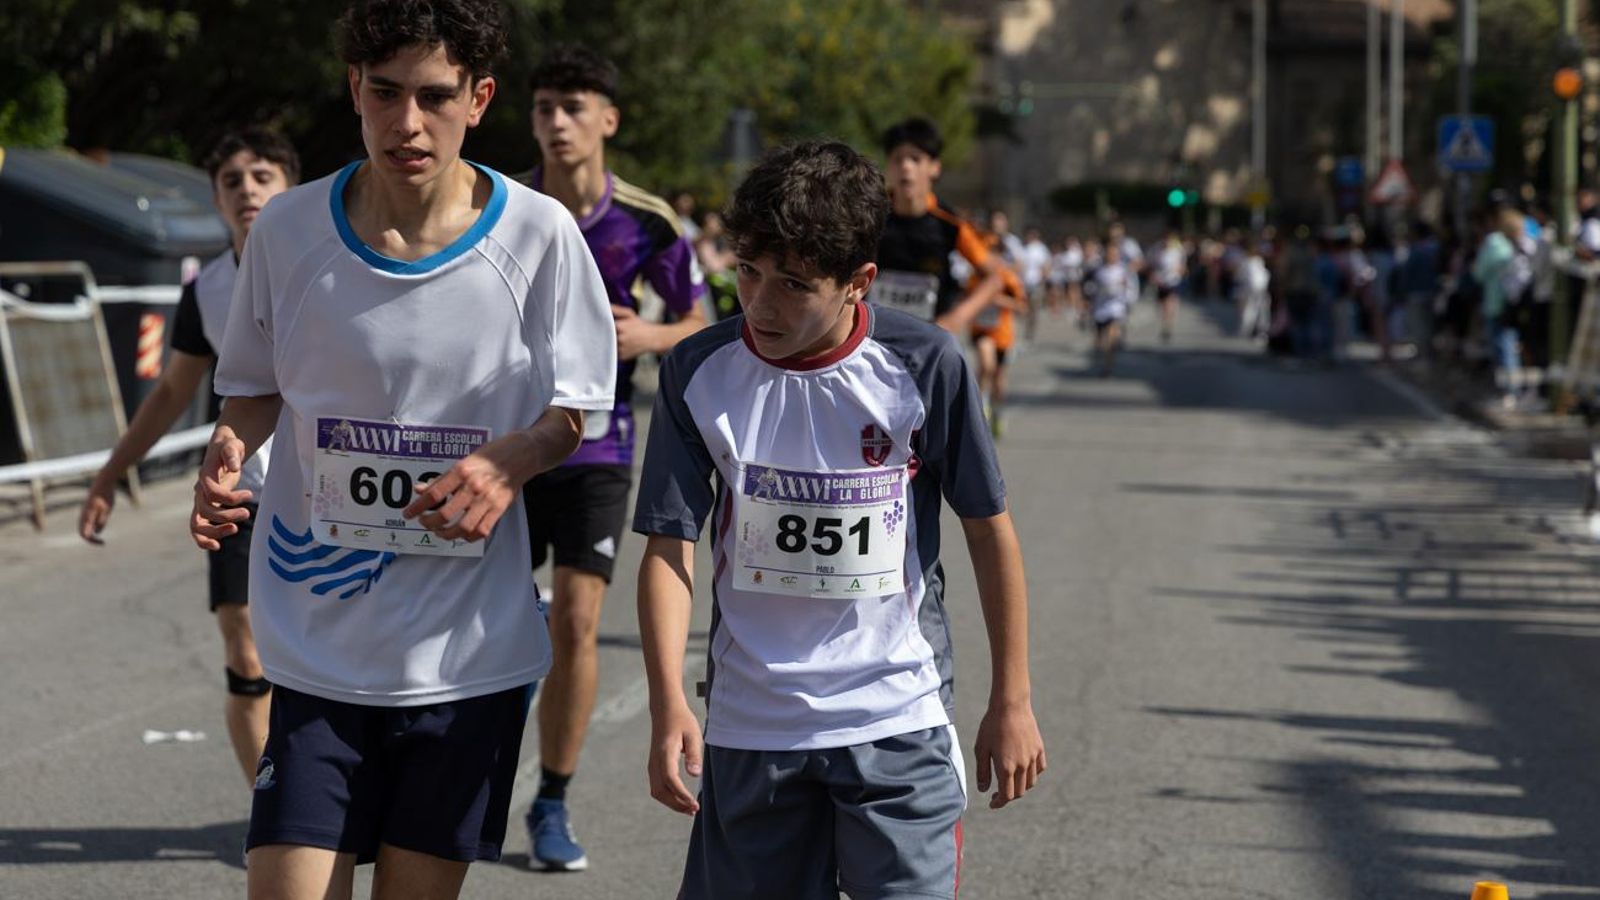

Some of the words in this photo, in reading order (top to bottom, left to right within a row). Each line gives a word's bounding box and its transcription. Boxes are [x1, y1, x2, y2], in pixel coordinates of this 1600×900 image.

[350, 425, 400, 452] XXXVI
[402, 430, 442, 443] CARRERA
[444, 432, 483, 446] ESCOLAR
[409, 443, 423, 454] LA
[431, 444, 471, 456] GLORIA
[775, 475, 830, 501] XXXVI
[832, 478, 870, 490] CARRERA
[871, 473, 900, 488] ESCOLAR
[840, 488, 853, 501] LA
[860, 485, 892, 500] GLORIA
[775, 514, 870, 557] 851
